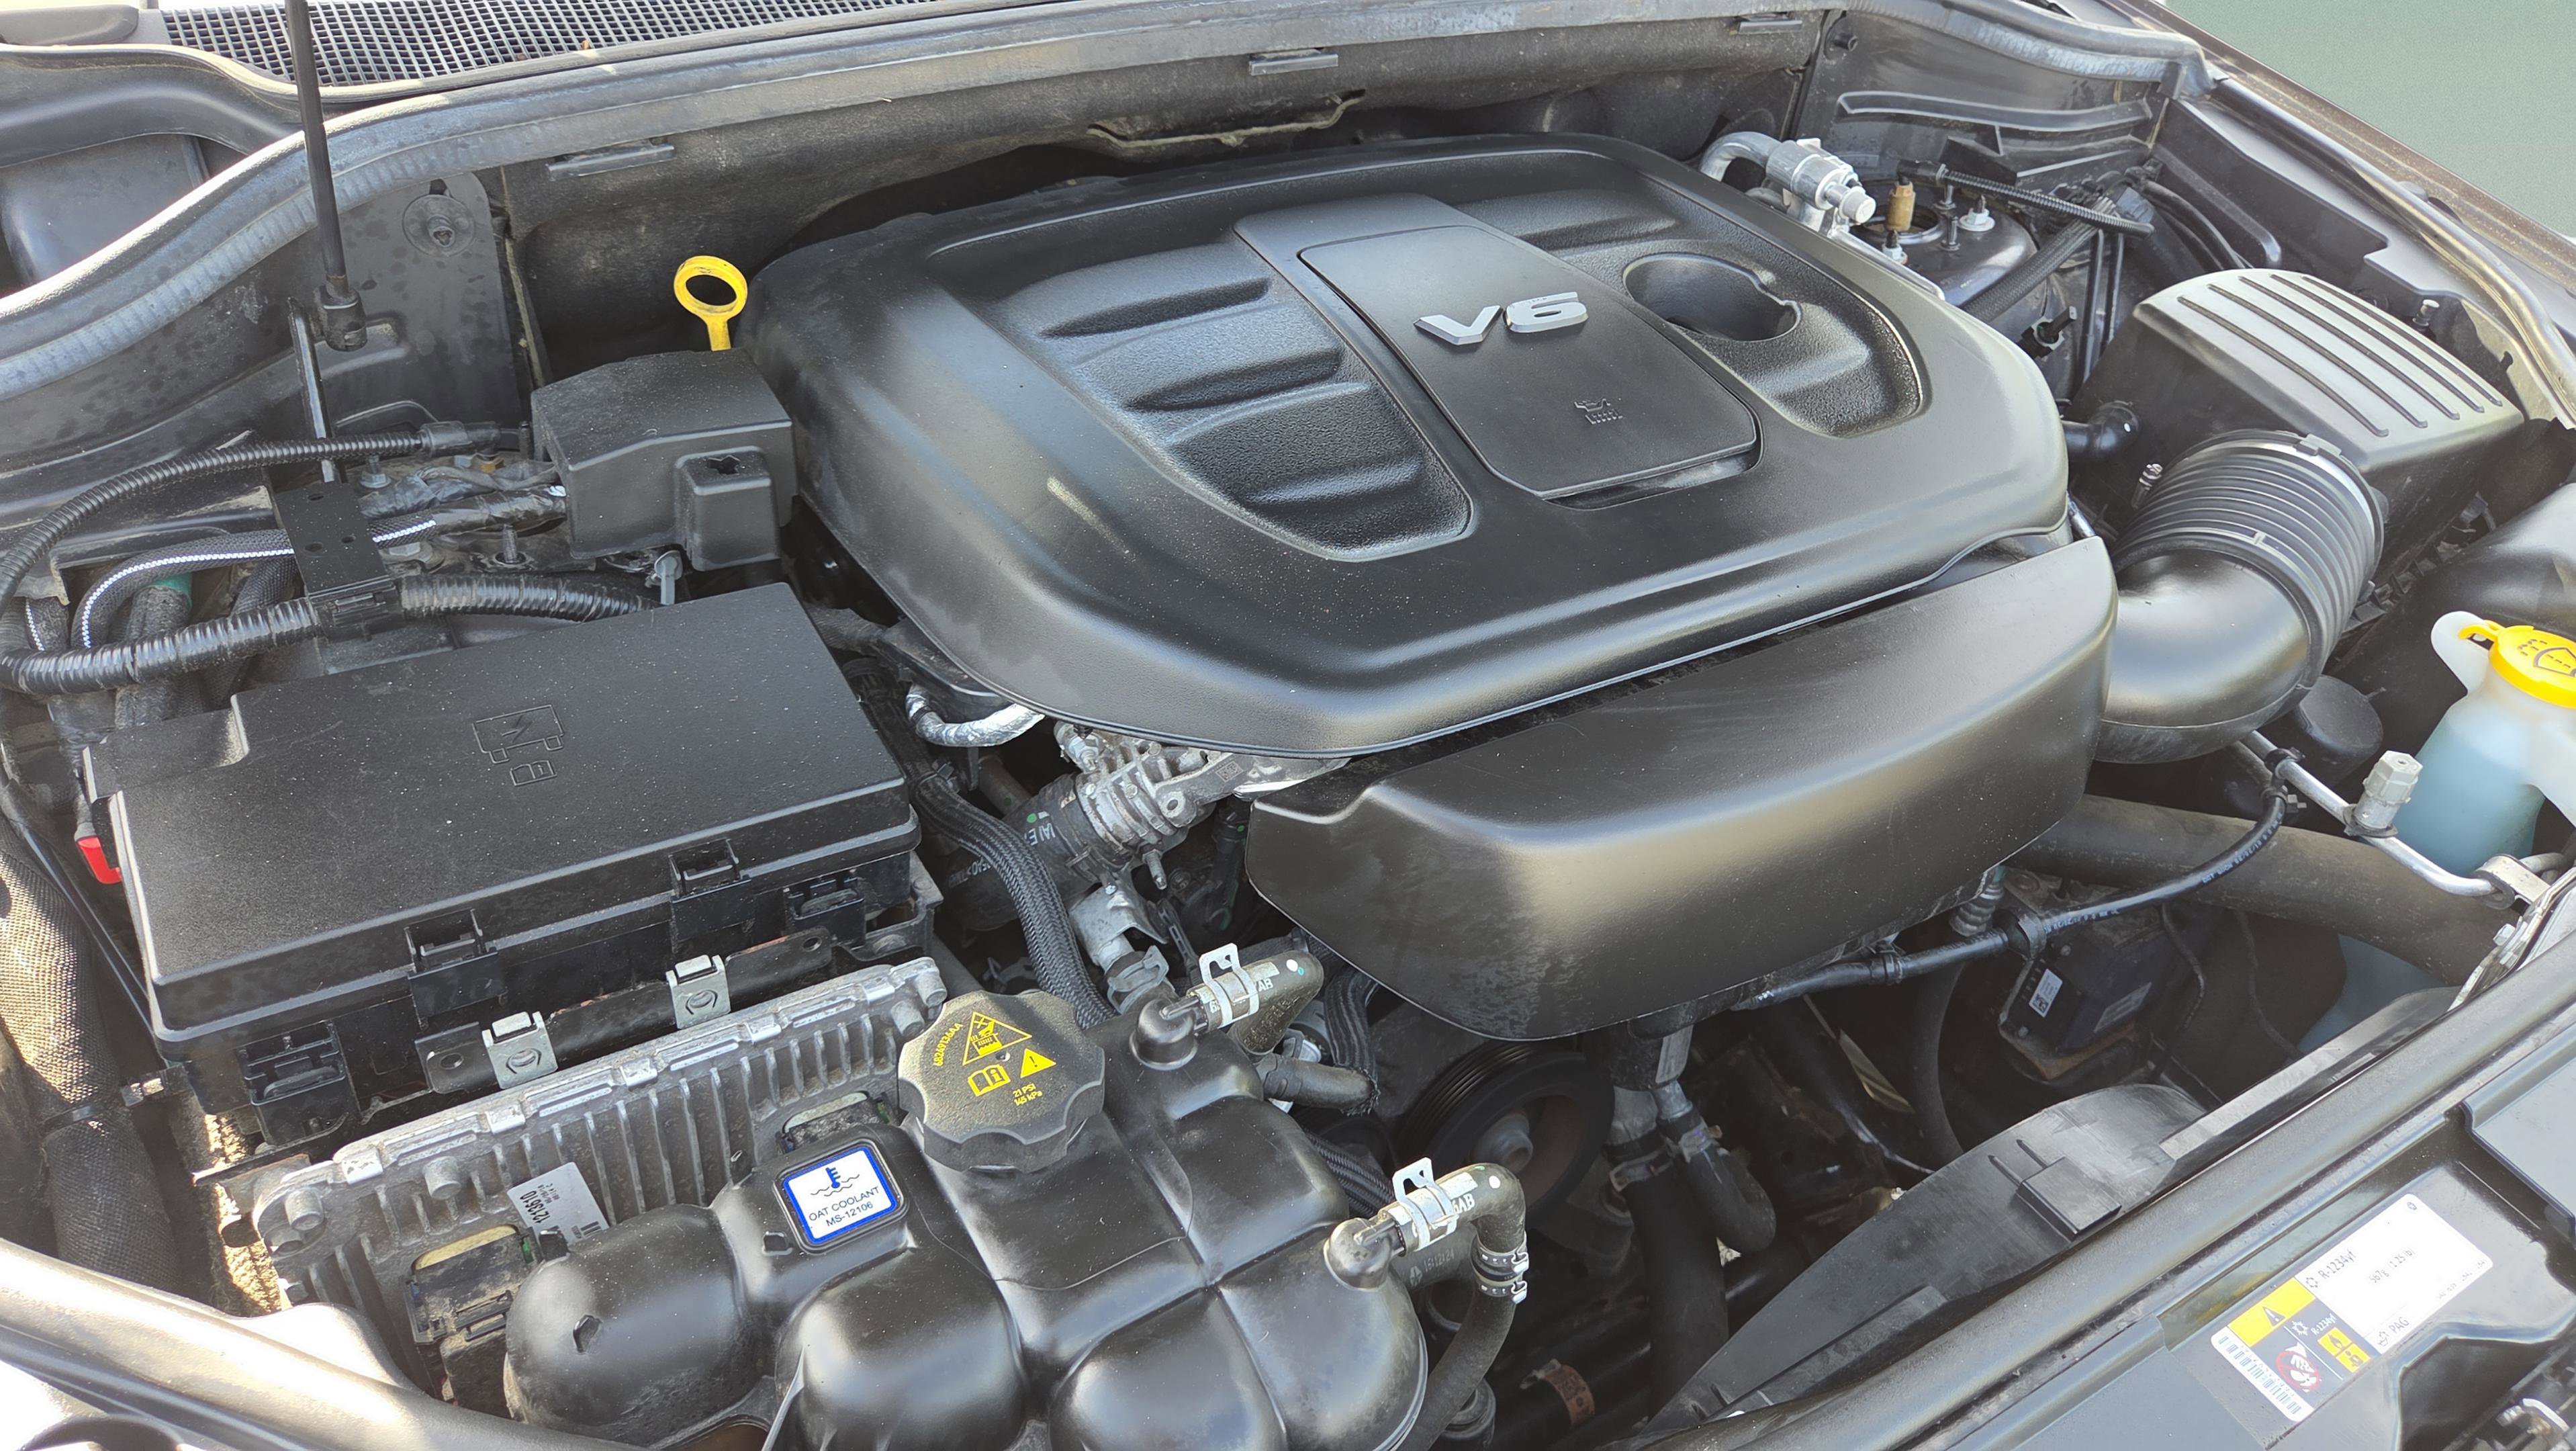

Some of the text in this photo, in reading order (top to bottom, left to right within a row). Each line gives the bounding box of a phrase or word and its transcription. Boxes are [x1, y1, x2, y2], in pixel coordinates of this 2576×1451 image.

[1413, 292, 1589, 346] V6
[933, 1023, 964, 1067] 68249136AA
[1013, 1083, 1036, 1098] 21 PSI
[1014, 1096, 1027, 1106] 145
[520, 1190, 551, 1224] 1213610
[809, 1187, 880, 1221] OAT COOLANT
[827, 1201, 873, 1226] MS-12106
[2317, 1248, 2356, 1280] R-1234yf
[2311, 1313, 2337, 1335] R-1234yf
[2389, 1317, 2410, 1334] PAG
